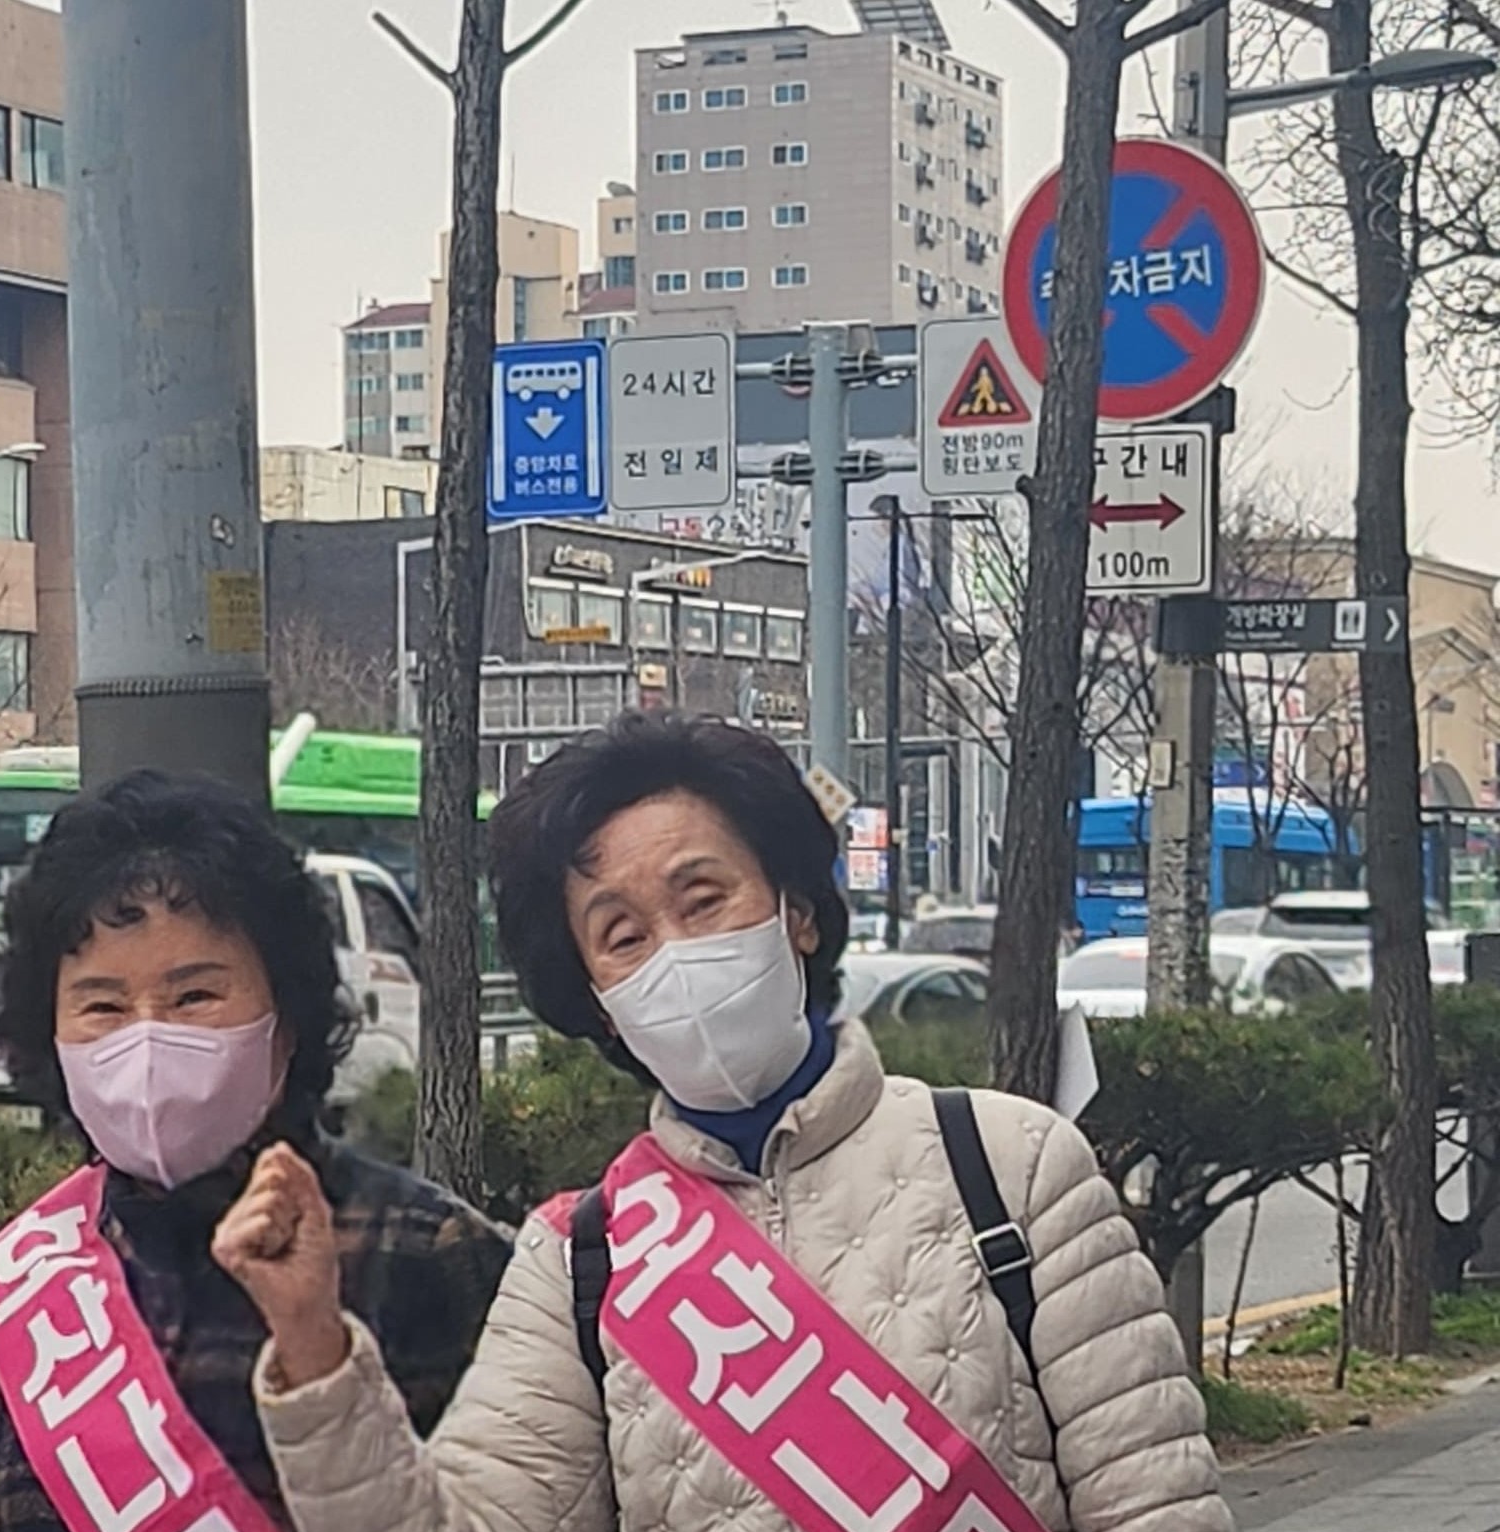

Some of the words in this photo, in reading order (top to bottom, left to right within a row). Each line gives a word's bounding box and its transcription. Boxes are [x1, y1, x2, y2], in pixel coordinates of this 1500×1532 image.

[622, 367, 716, 397] 24시간
[942, 432, 1024, 455] 전방90m
[514, 454, 579, 475] 중앙차로
[942, 453, 1024, 477] 횡단보도
[514, 476, 579, 498] 버스전용
[1097, 551, 1171, 579] 100m
